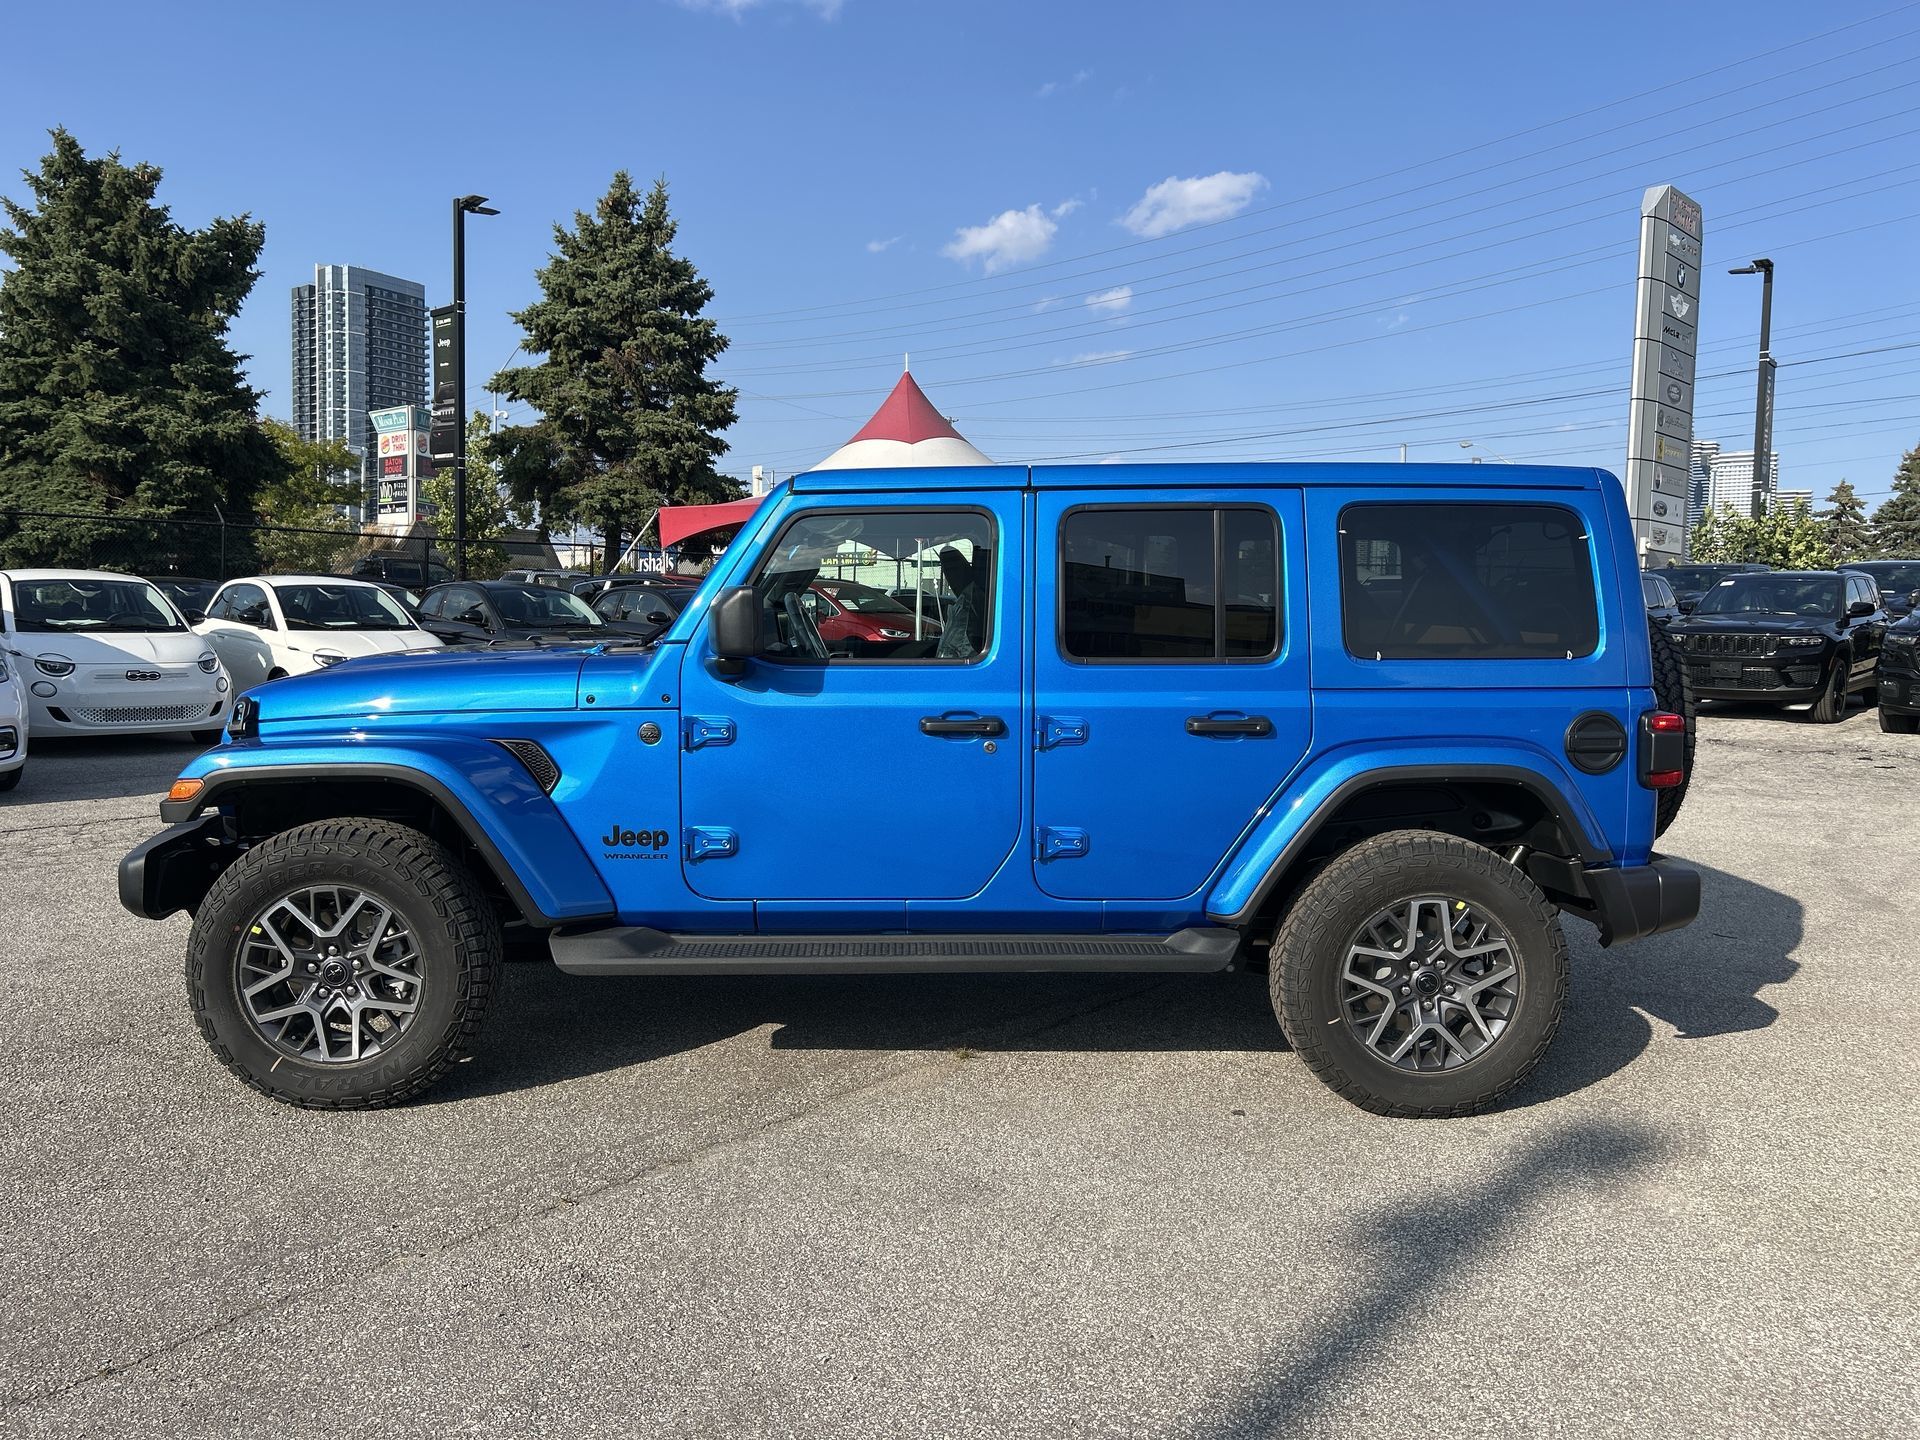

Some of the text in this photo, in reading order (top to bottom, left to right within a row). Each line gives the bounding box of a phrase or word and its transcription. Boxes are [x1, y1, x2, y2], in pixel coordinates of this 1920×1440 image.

[437, 338, 451, 348] Jeep
[391, 433, 407, 443] DRIVE
[392, 443, 406, 452] THRU
[384, 465, 402, 474] ROUGE
[620, 551, 675, 572] Mrshals
[602, 824, 669, 850] Jeep
[290, 1030, 433, 1091] GENERAL
